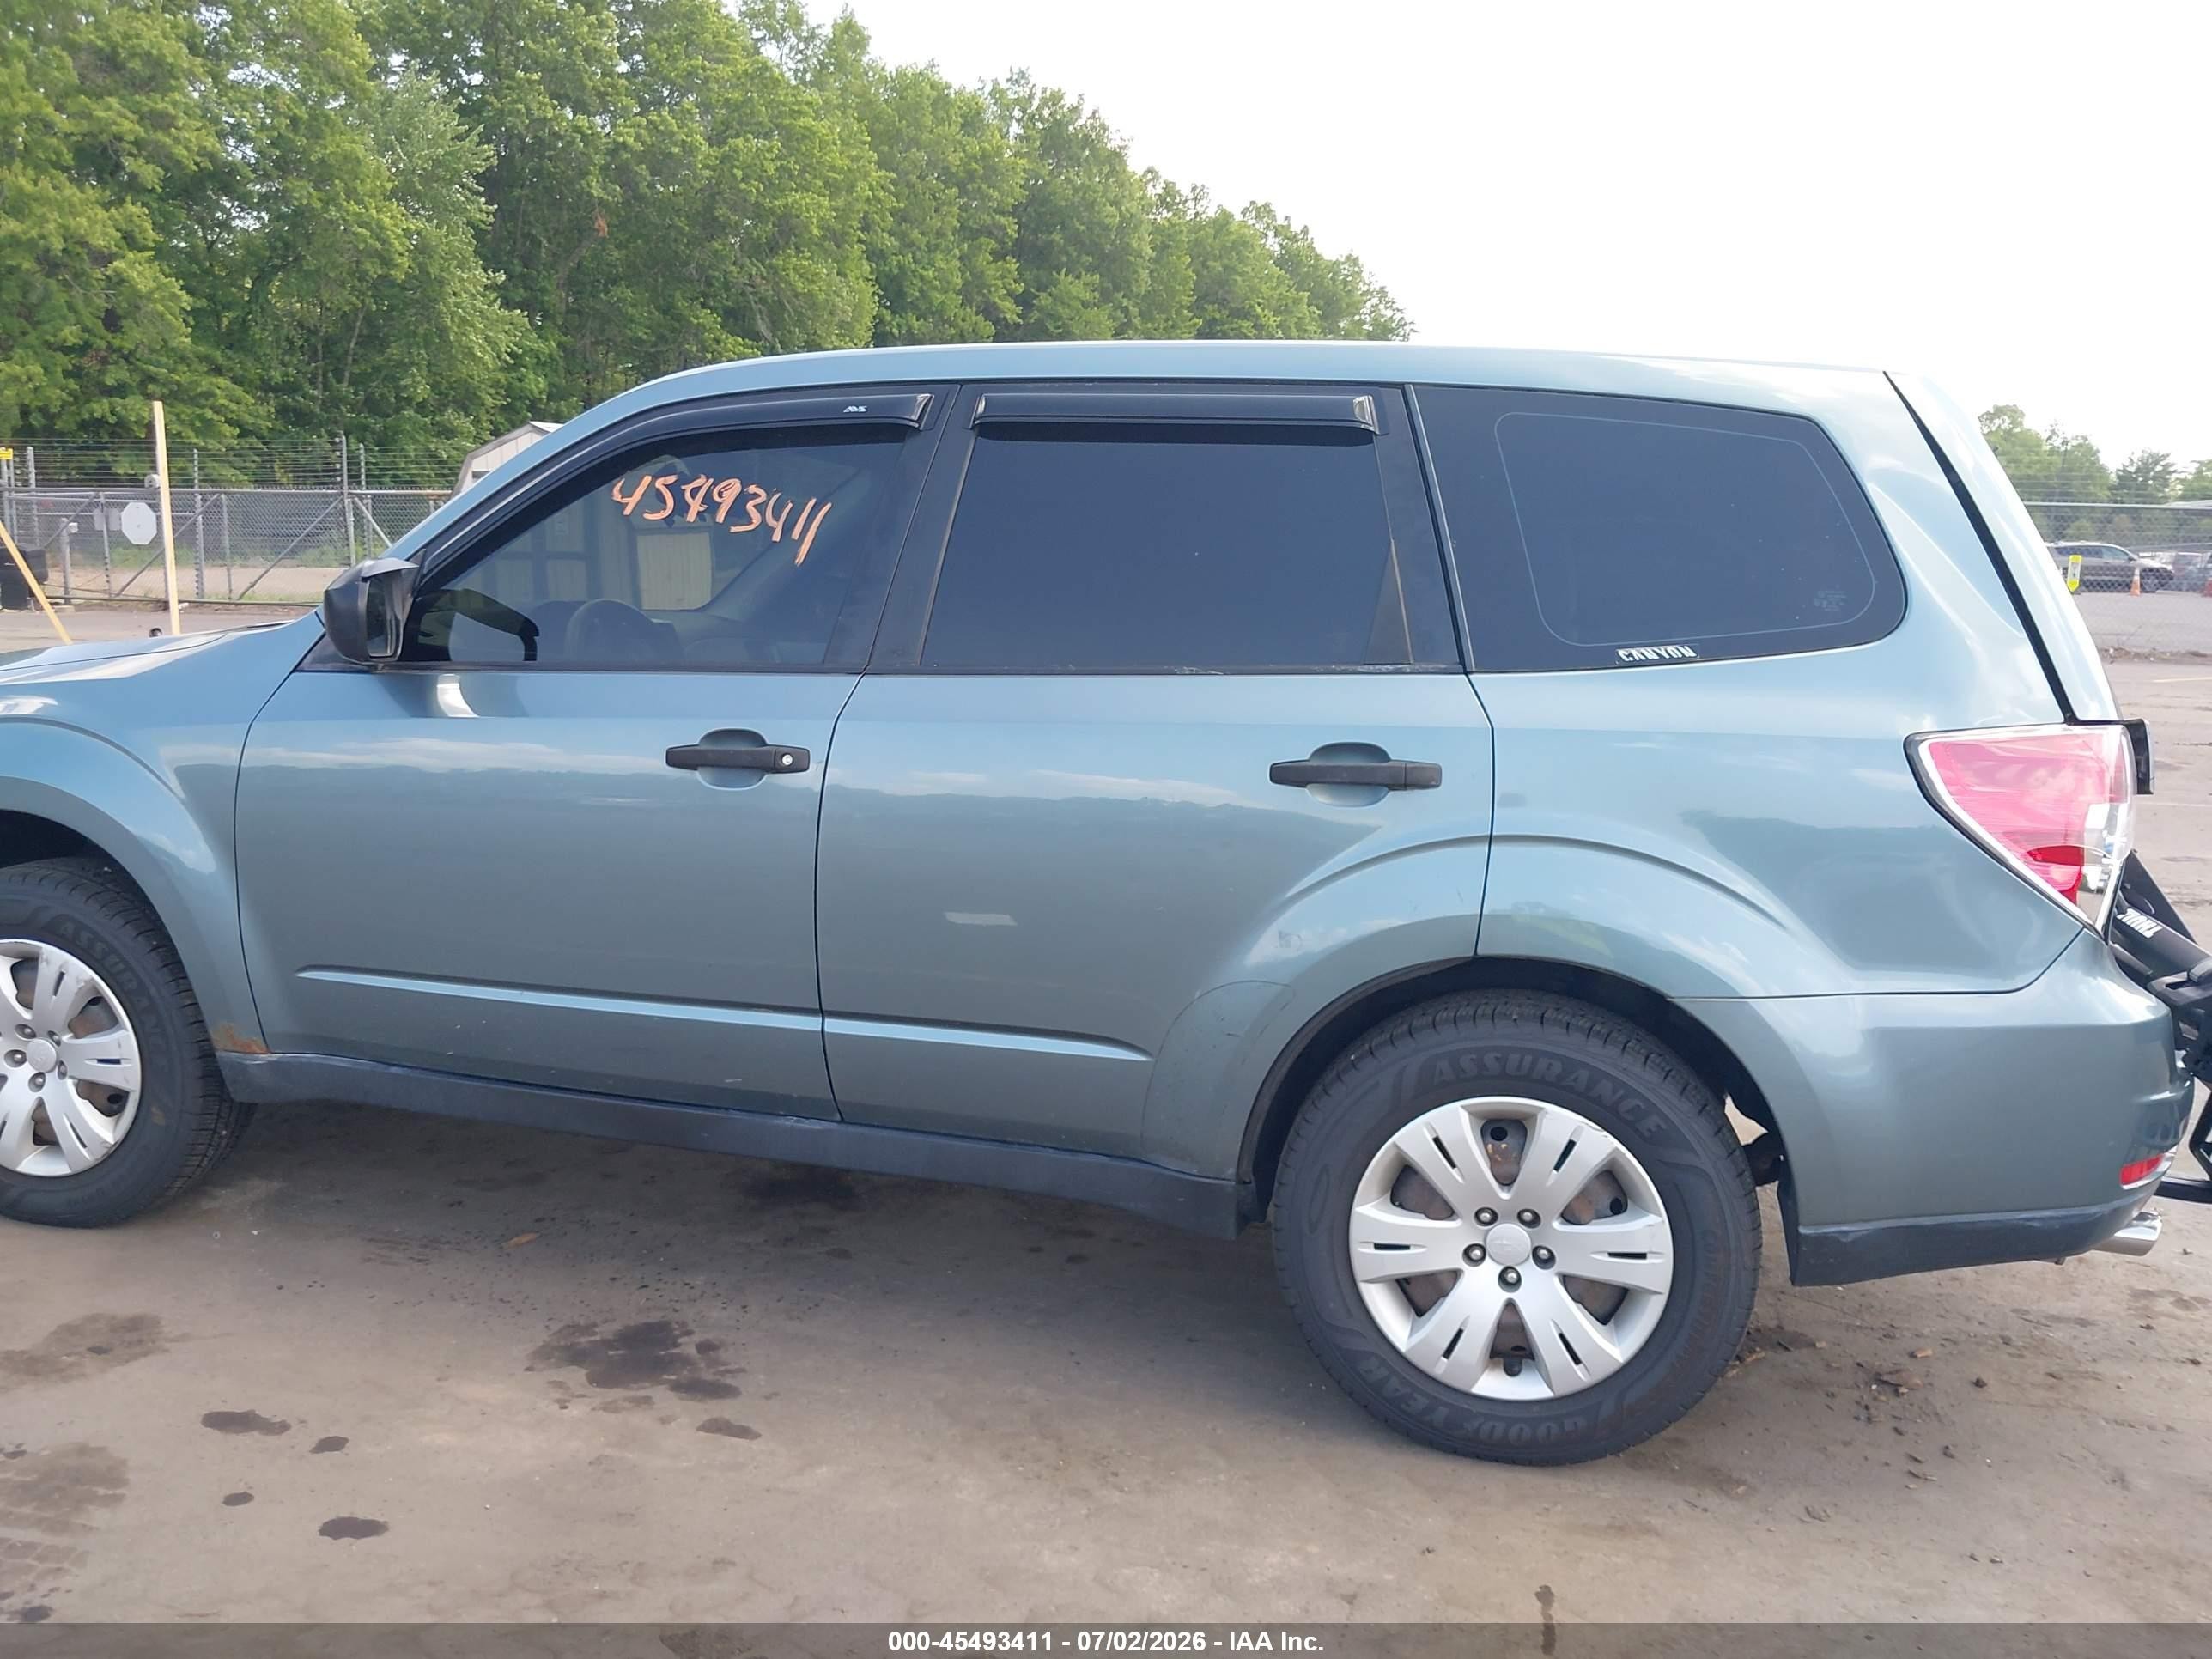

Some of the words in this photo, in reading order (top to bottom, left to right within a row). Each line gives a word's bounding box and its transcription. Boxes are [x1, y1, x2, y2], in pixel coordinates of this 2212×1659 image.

[611, 474, 833, 567] 45493411
[1618, 646, 1698, 662] CANYON
[2116, 908, 2163, 939] THULE
[1431, 1052, 1668, 1139] ASSURANCE
